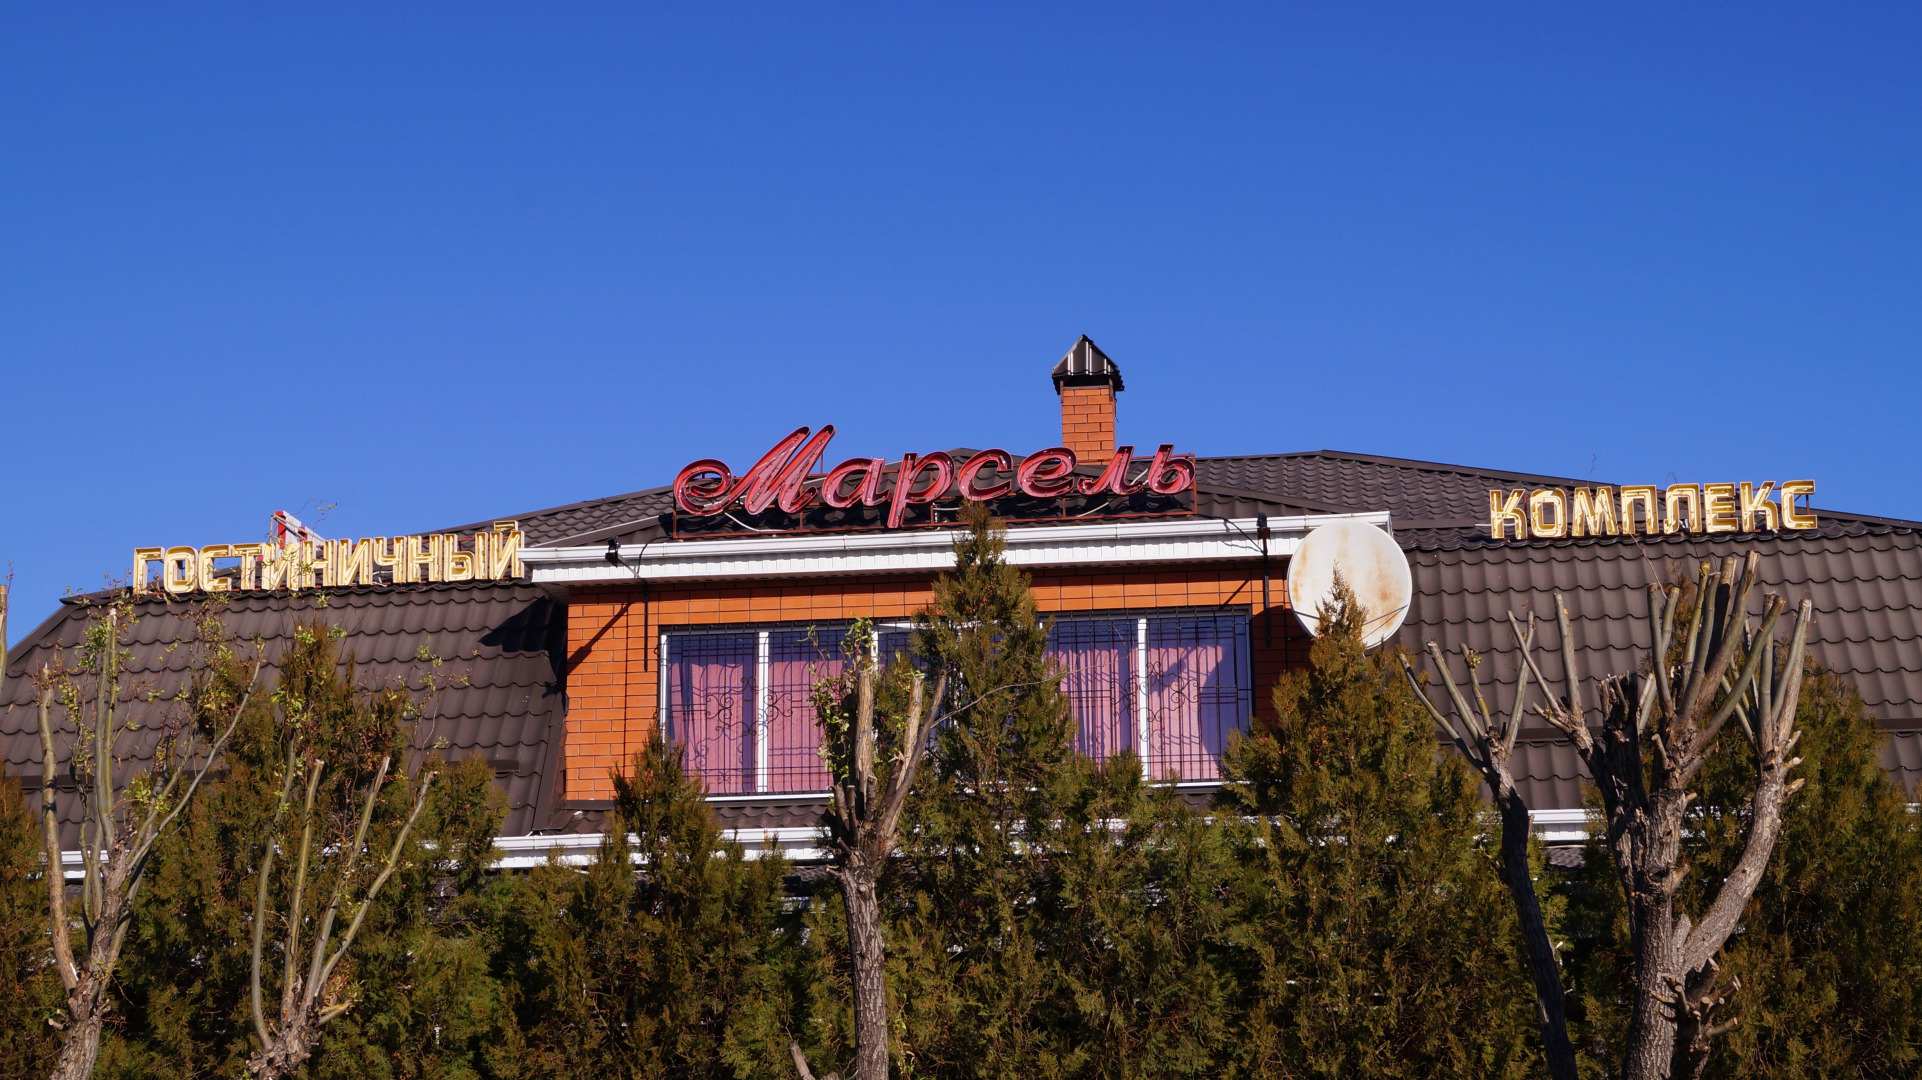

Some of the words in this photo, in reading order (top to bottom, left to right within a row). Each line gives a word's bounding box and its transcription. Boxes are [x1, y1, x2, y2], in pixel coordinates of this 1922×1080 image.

[674, 424, 1196, 528] Марсель
[1489, 479, 1817, 539] КОМПЛЕКС
[132, 520, 525, 595] ГОСТИНИЧНЫЙ
